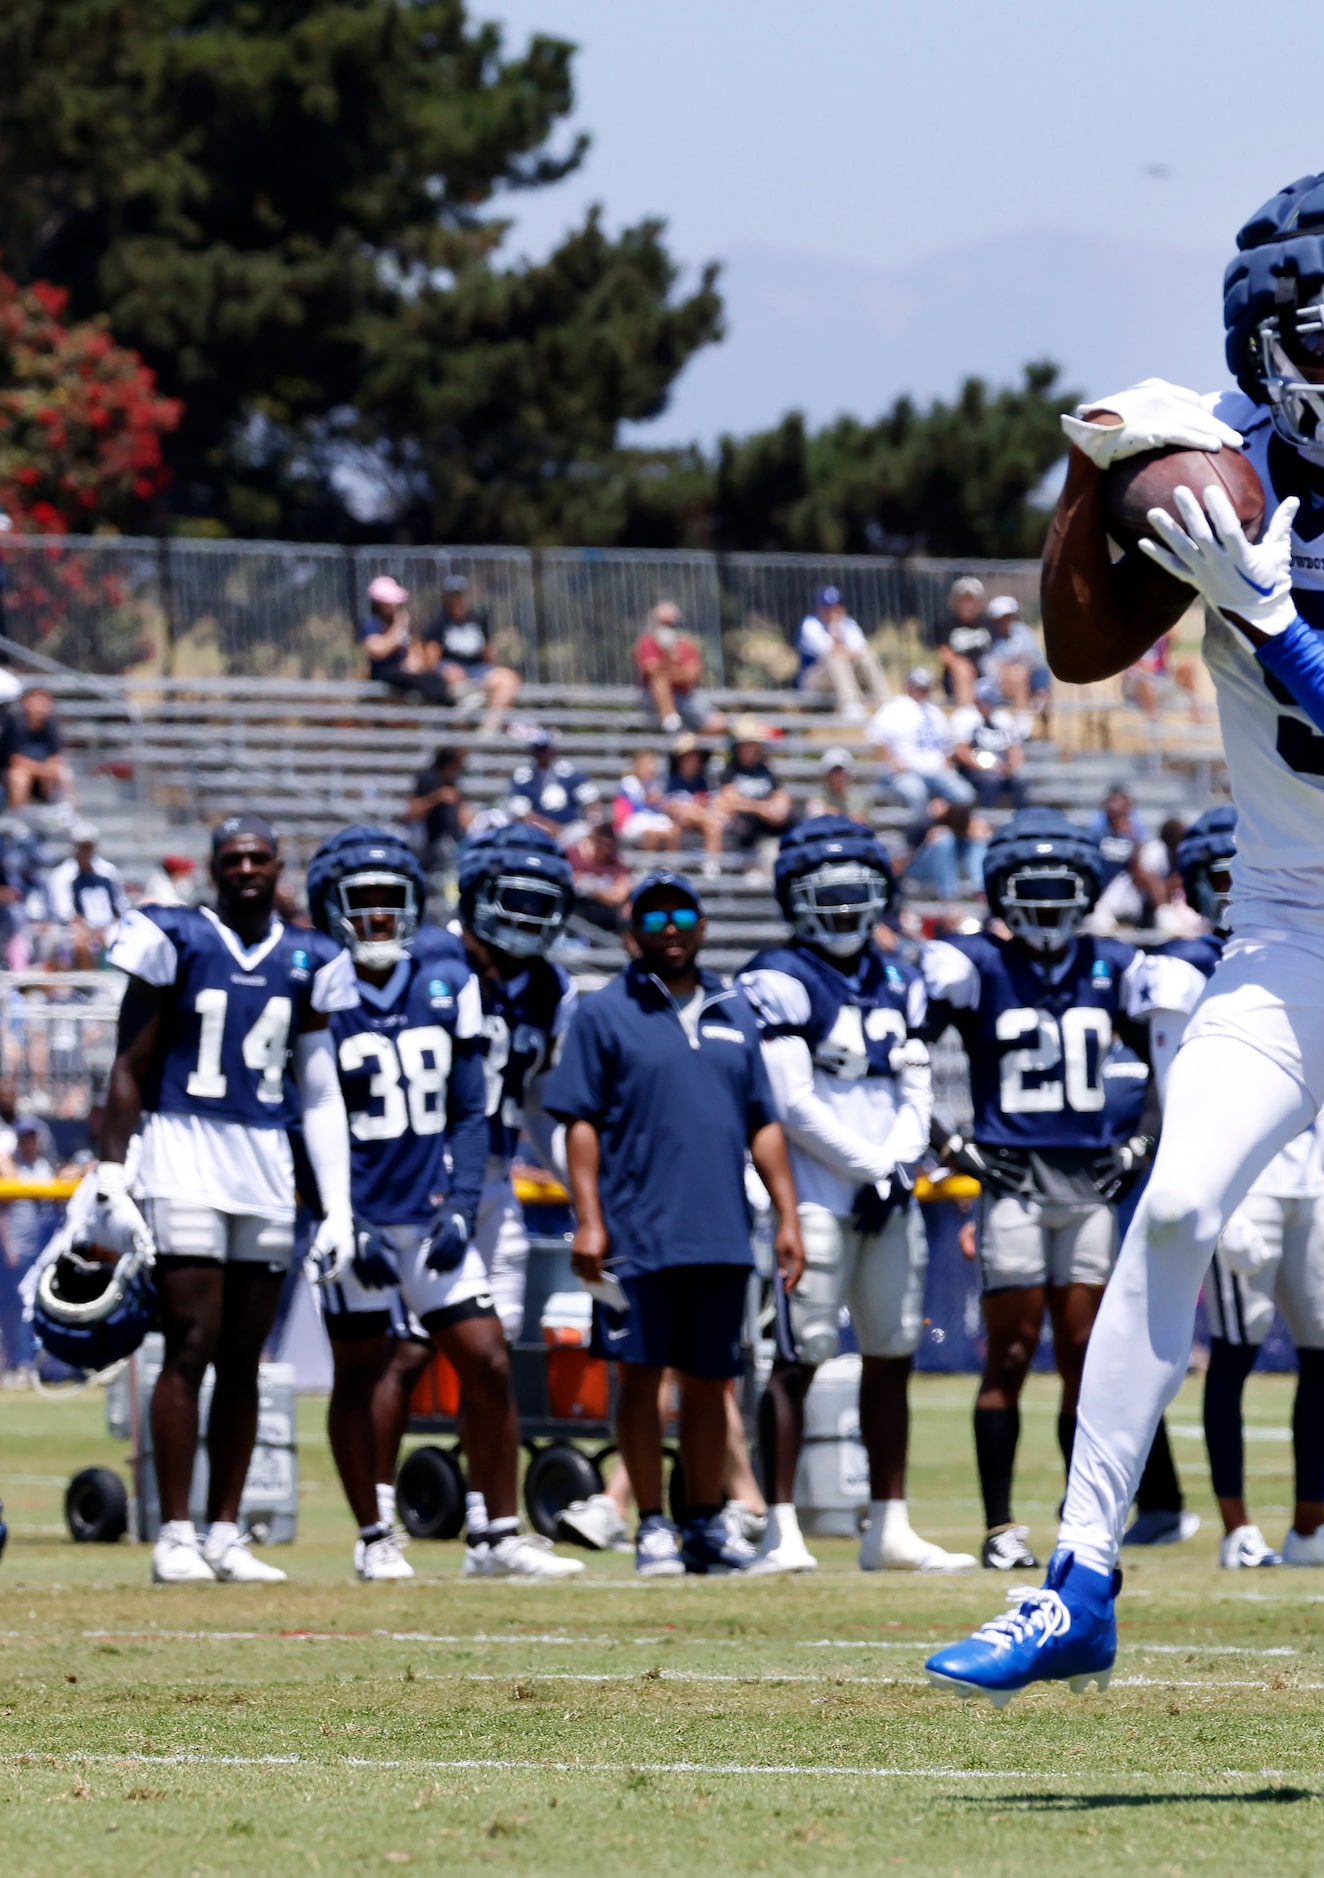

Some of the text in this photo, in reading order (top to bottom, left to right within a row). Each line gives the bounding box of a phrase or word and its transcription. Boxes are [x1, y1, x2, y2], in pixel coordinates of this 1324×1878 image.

[187, 988, 292, 1104] 14
[339, 1025, 452, 1141] 38
[996, 1007, 1112, 1113] 20
